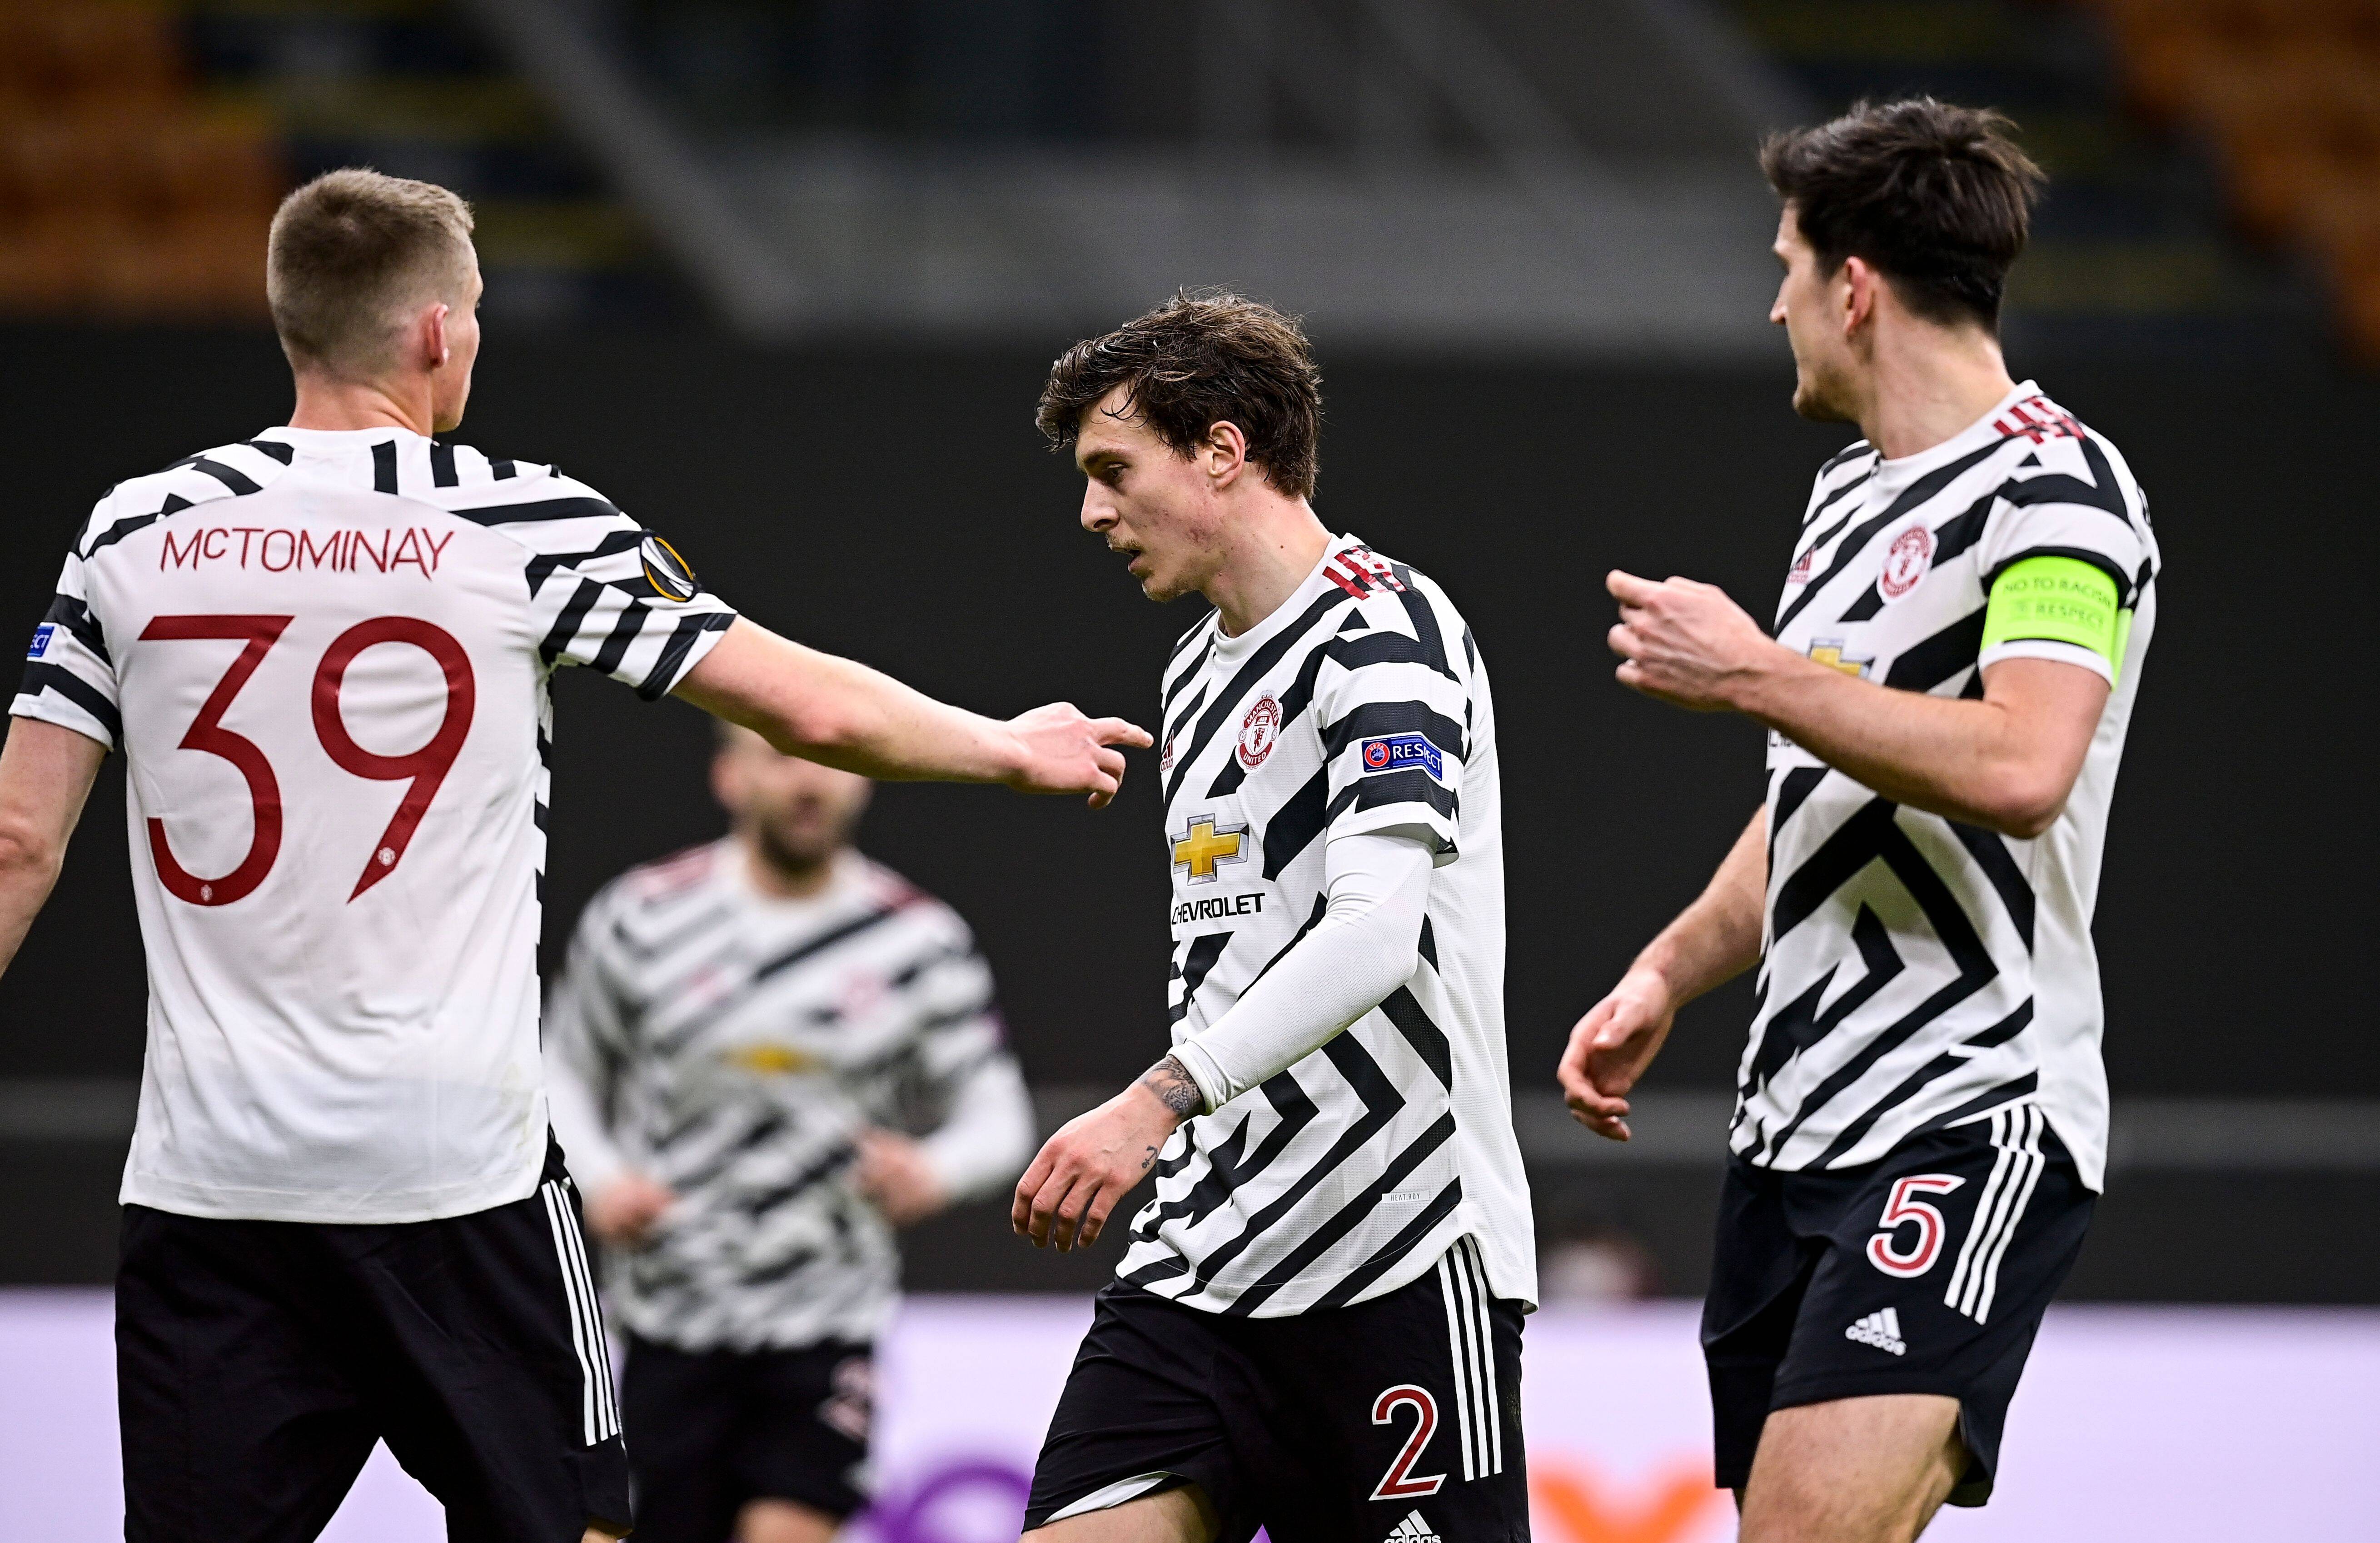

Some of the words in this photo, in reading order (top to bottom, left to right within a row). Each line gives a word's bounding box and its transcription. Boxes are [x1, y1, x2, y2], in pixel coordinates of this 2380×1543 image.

[1246, 700, 1279, 725] MANCHESTER
[138, 614, 476, 907] 39
[1243, 751, 1266, 765] UNITED
[1393, 744, 1442, 771] RESPECT
[1171, 892, 1265, 925] CHEVROLET
[1866, 1173, 1967, 1278] 5
[1845, 1325, 1907, 1356] adidas
[1368, 1384, 1447, 1501] 2
